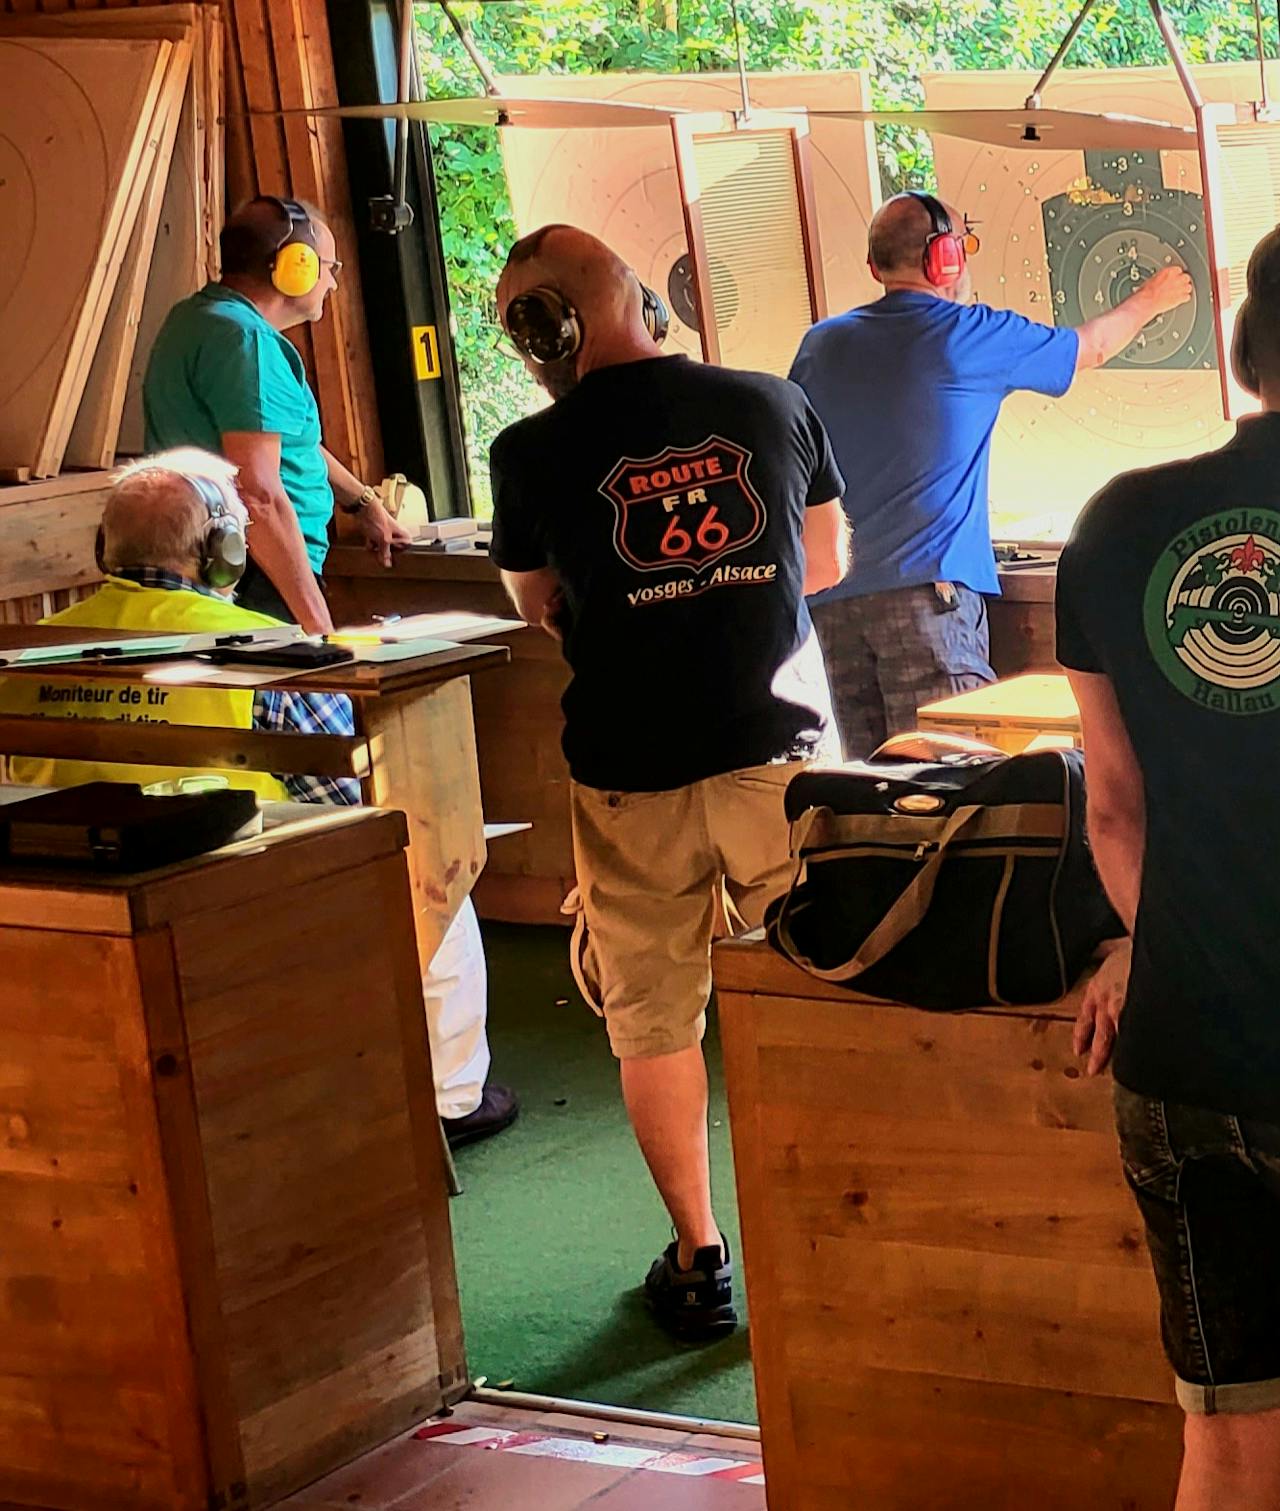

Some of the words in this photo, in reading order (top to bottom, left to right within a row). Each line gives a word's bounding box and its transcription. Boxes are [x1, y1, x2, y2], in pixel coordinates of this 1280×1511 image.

[1117, 156, 1128, 171] 3
[1123, 202, 1134, 217] 3
[1029, 290, 1038, 303] 2
[1055, 290, 1066, 304] 3
[1095, 289, 1105, 304] 4
[420, 331, 435, 373] 1
[629, 456, 723, 495] ROUTE
[660, 505, 729, 557] 66
[710, 563, 777, 586] Alsace
[39, 685, 115, 704] Moniteur
[118, 686, 142, 704] de
[147, 687, 171, 706] tir
[1190, 681, 1276, 712] Hallau
